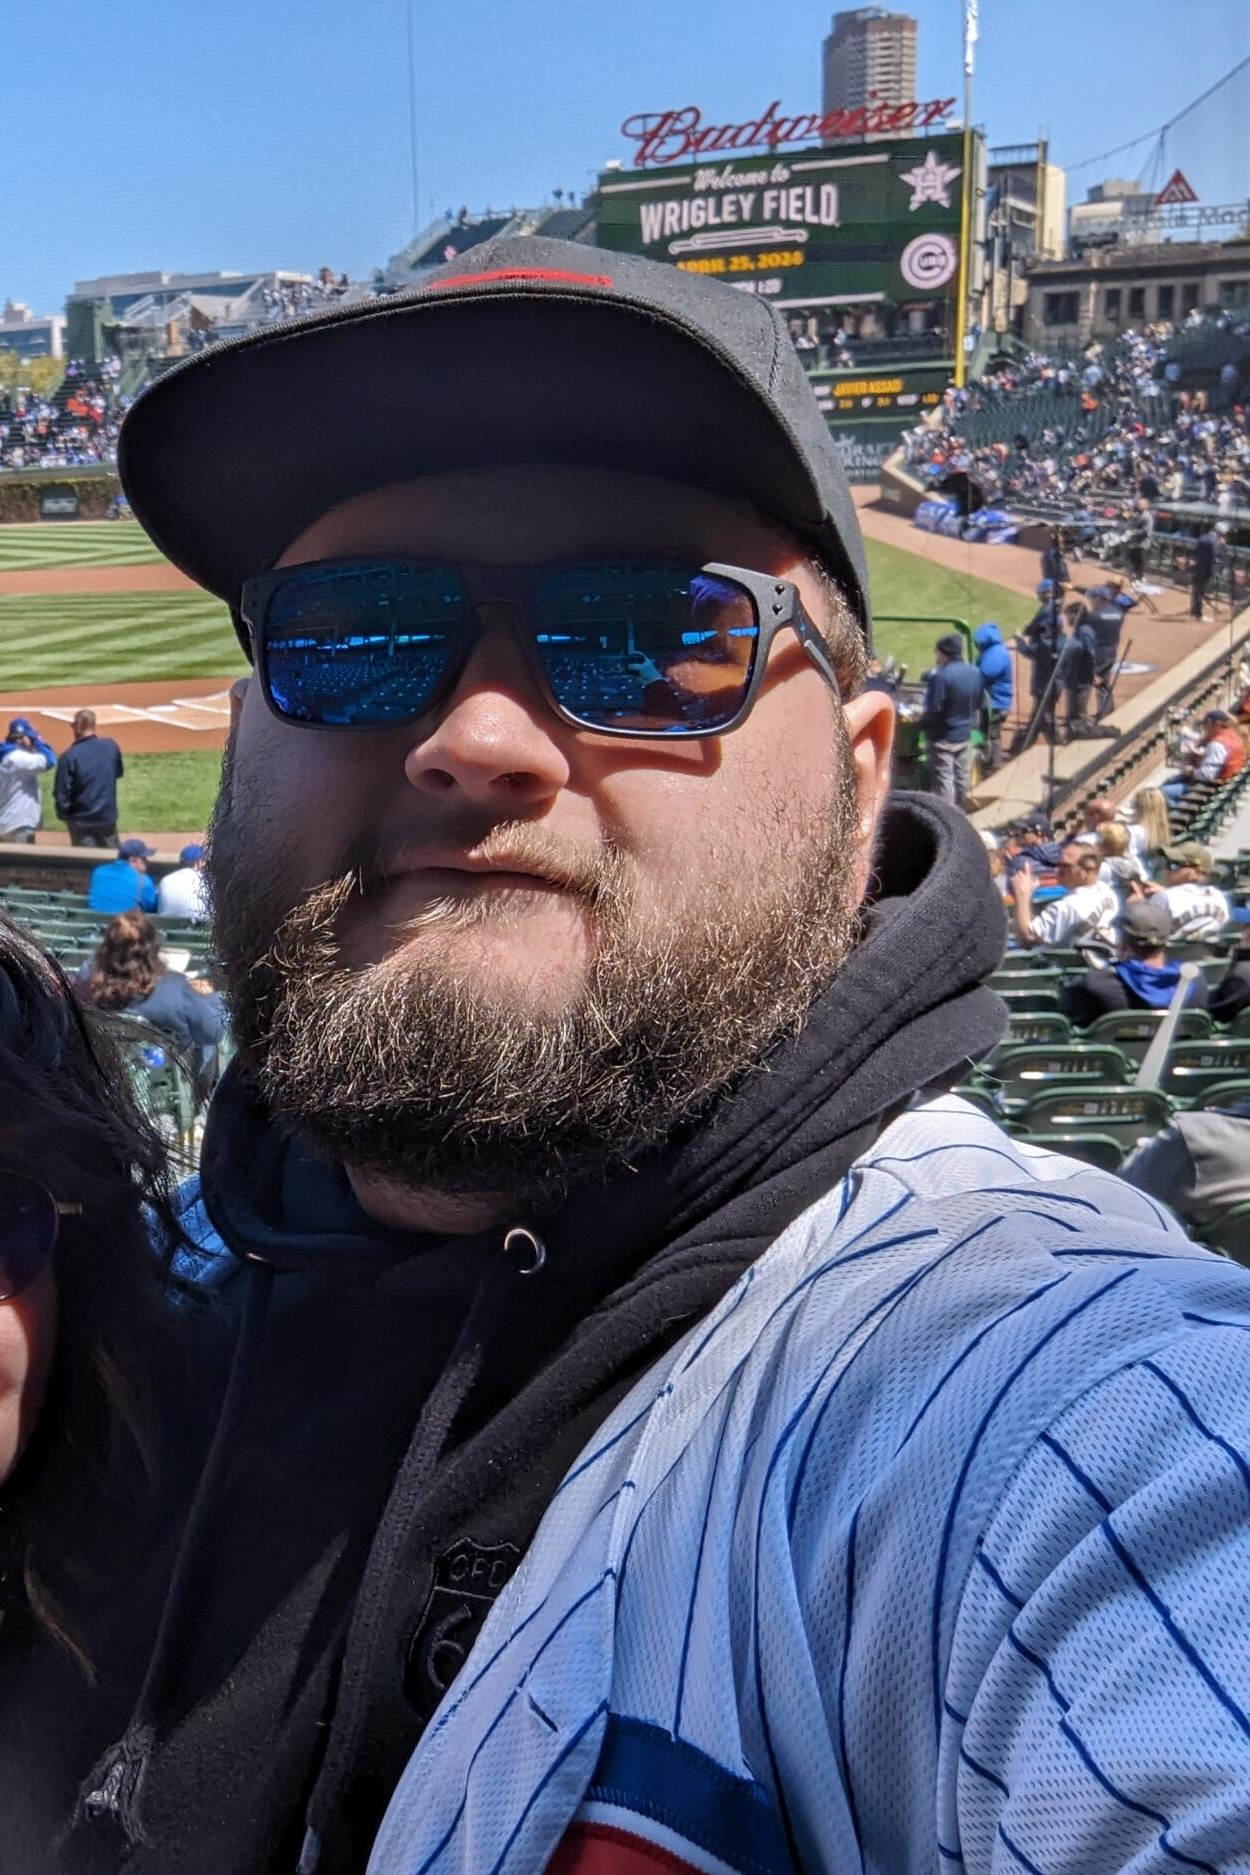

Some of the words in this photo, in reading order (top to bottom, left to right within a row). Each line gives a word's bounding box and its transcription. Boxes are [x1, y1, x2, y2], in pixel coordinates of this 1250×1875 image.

[621, 90, 956, 166] Budweiser
[693, 165, 767, 191] Welcome
[770, 162, 790, 183] to
[640, 193, 754, 245] WRIGLEY
[763, 184, 841, 229] FIELD
